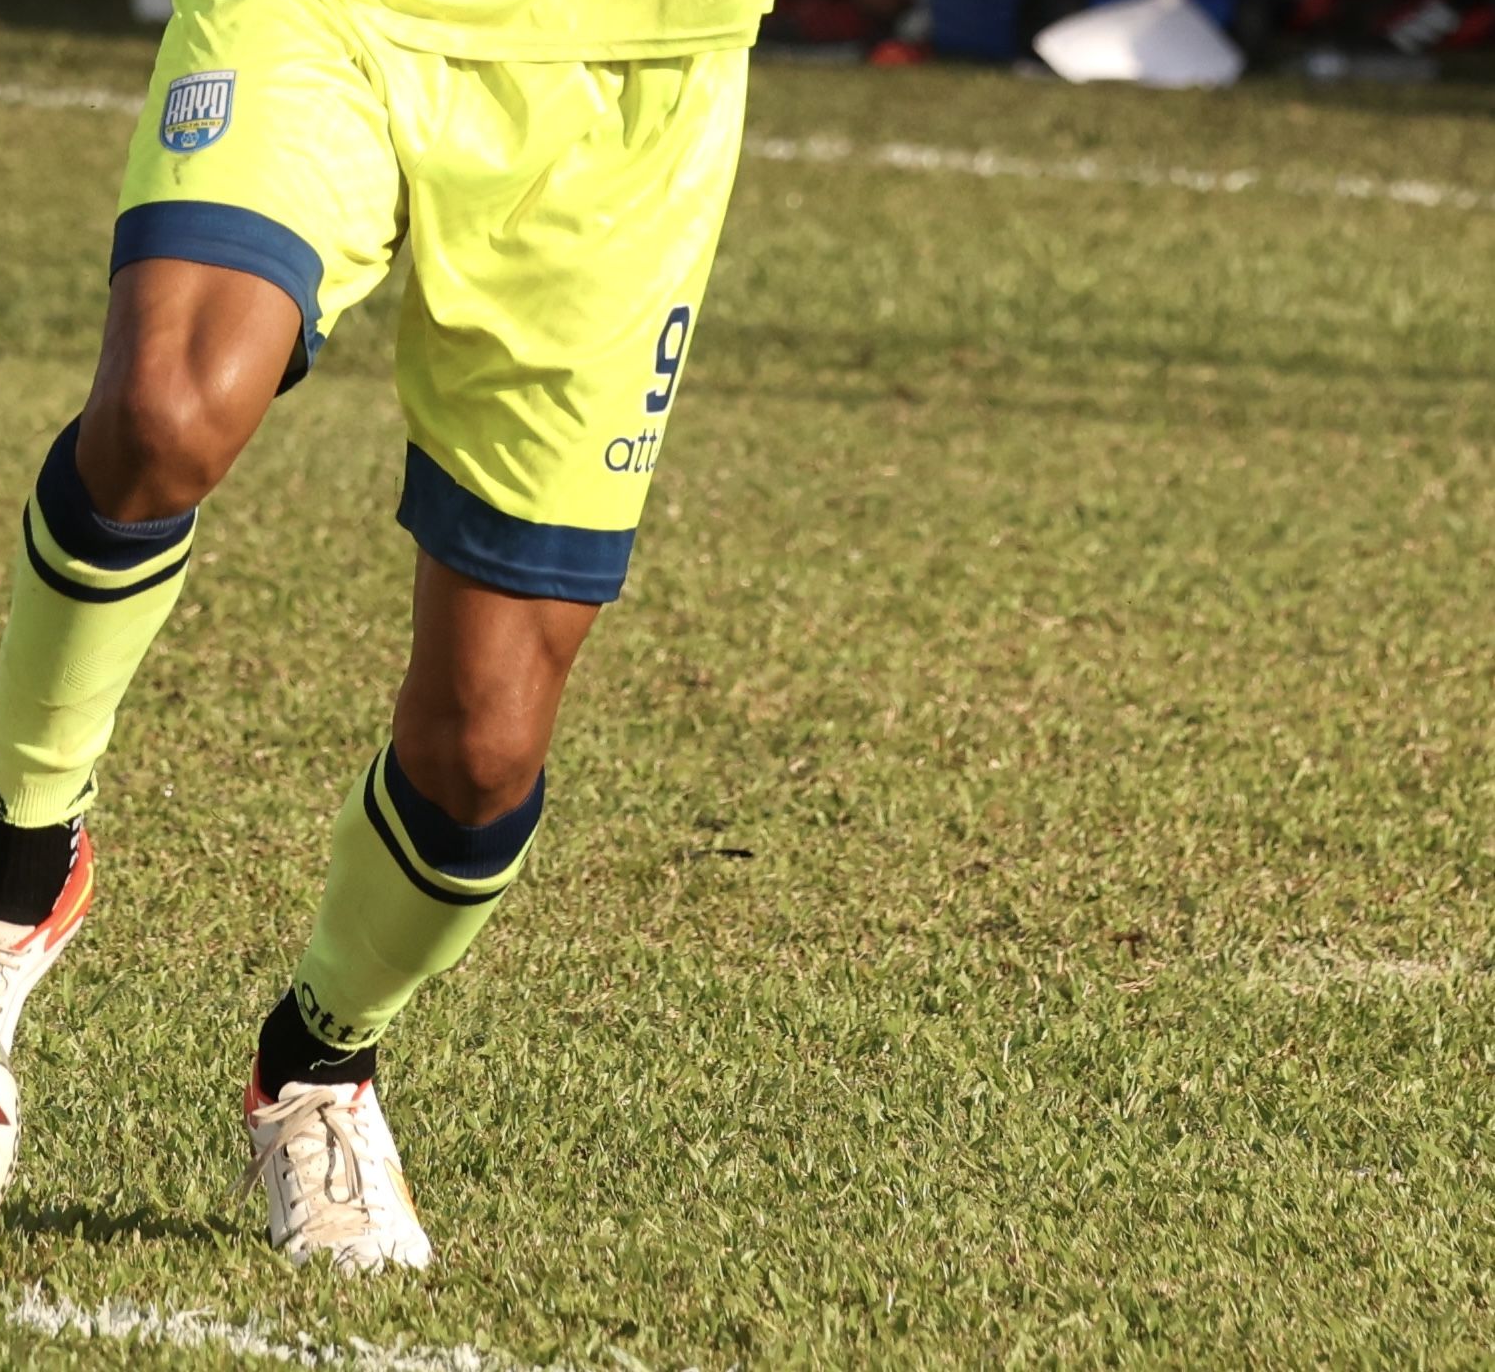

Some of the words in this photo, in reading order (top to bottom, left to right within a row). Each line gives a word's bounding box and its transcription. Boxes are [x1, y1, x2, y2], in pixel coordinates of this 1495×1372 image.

[165, 81, 229, 126] RAYO
[646, 305, 691, 414] 9
[604, 428, 659, 474] att
